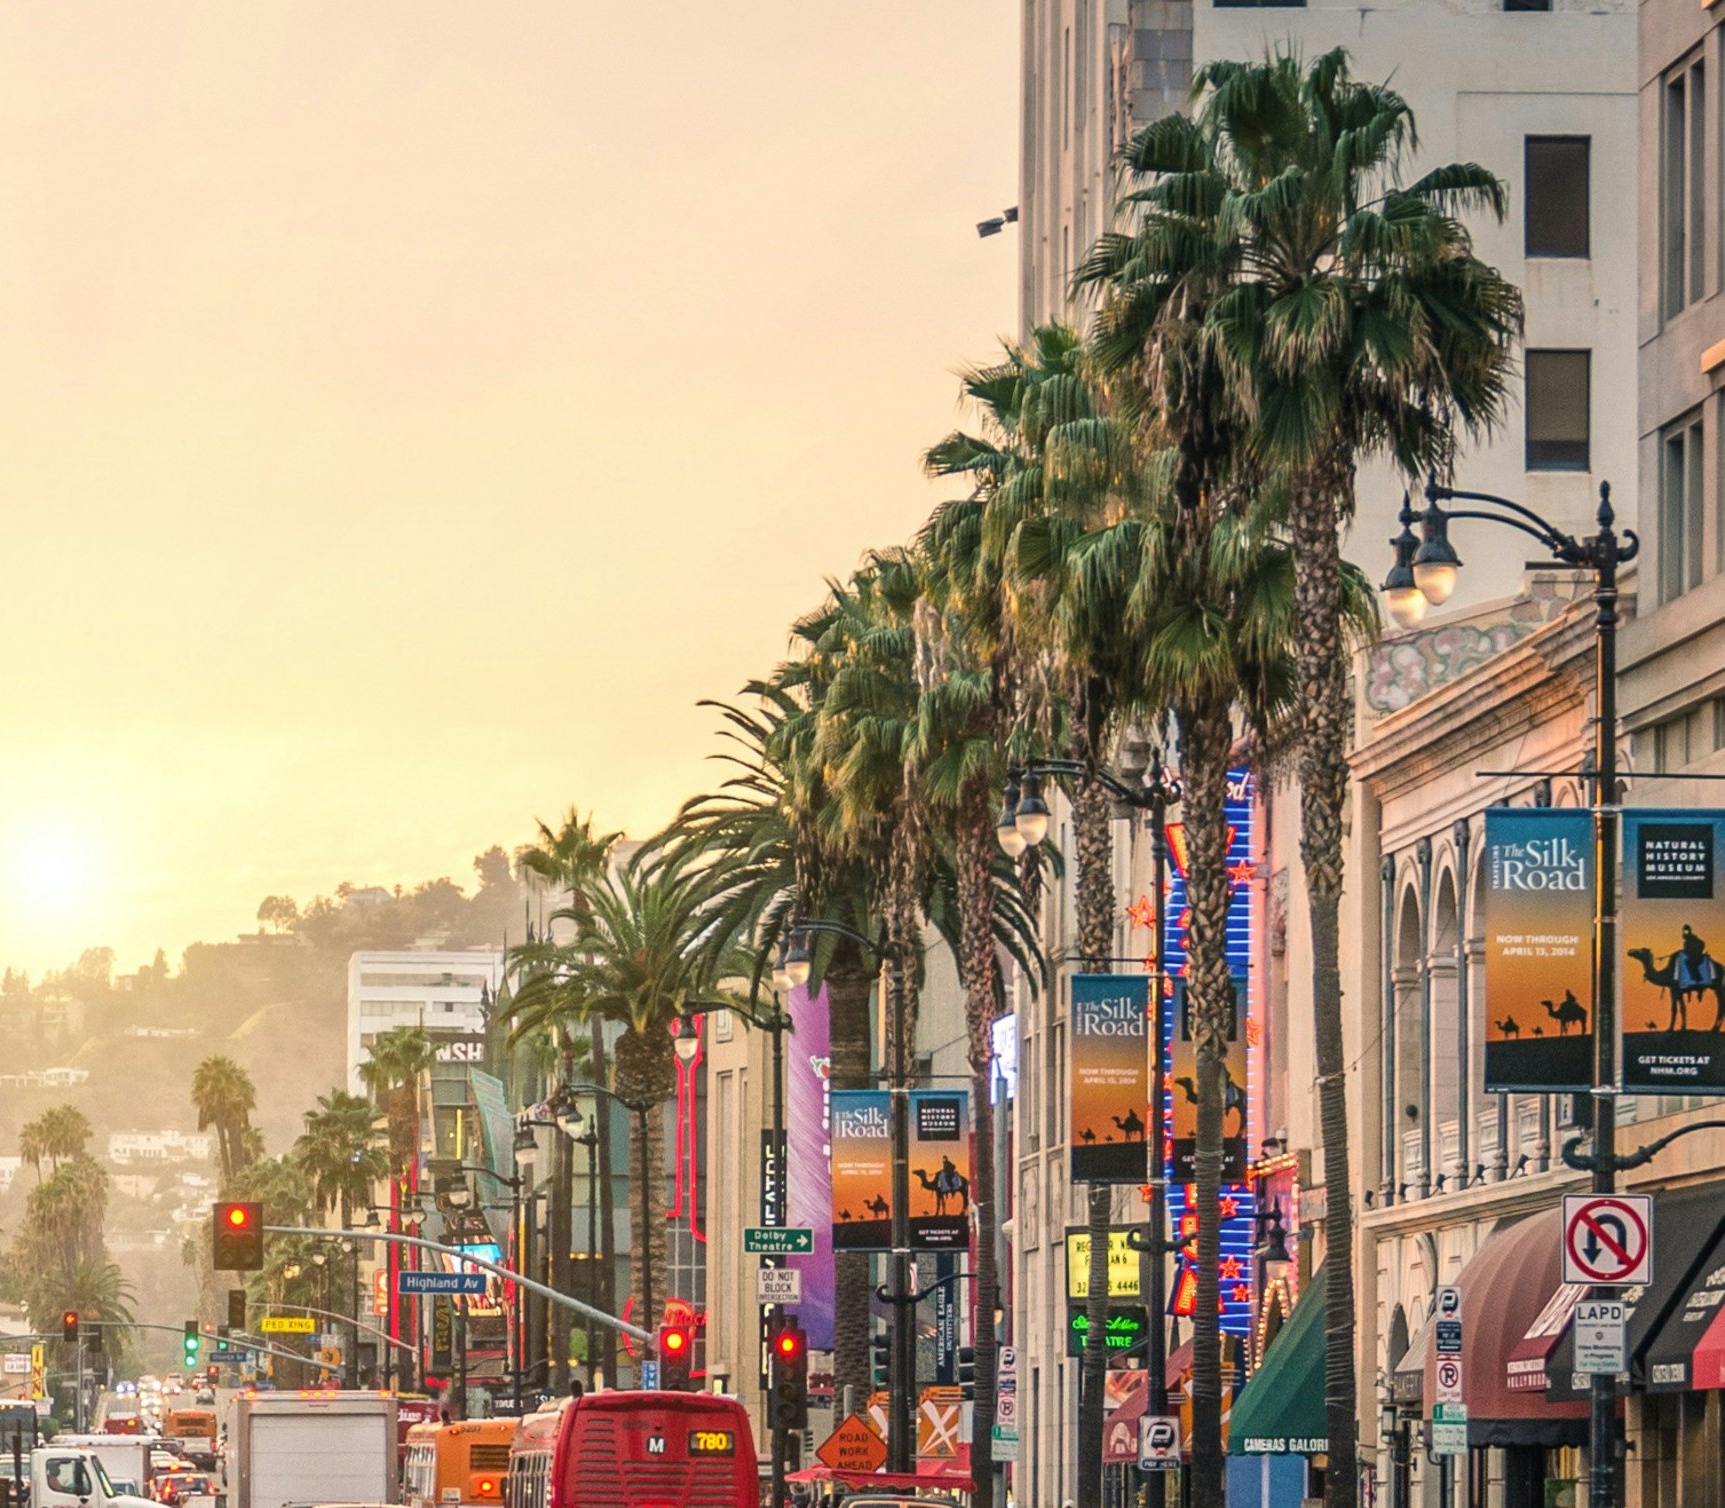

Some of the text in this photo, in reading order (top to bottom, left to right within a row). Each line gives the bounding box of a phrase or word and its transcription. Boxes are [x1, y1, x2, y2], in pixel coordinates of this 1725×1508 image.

[1645, 840, 1705, 850] NATURAL
[1503, 837, 1578, 868] The Silk
[1645, 852, 1705, 861] HISTORY
[1645, 863, 1705, 872] MUSEUM
[1503, 857, 1587, 891] Road
[1496, 934, 1579, 944] NOW THROUGH
[1502, 947, 1532, 956] APRIL
[1100, 997, 1138, 1020] Silk
[1084, 1012, 1145, 1037] Road
[1637, 1055, 1710, 1065] GET TICKETS AT
[1650, 1066, 1698, 1075] NHM.ORG
[853, 1106, 884, 1125] Silk
[840, 1119, 889, 1138] Road
[754, 1230, 787, 1242] Dolby
[749, 1241, 793, 1251] Theatre
[761, 1271, 794, 1282] DO NOT
[406, 1276, 479, 1291] Highland Av
[764, 1282, 792, 1293] BLOCK
[1577, 1306, 1621, 1320] LAPD
[265, 1320, 312, 1330] PED XING
[937, 1313, 945, 1367] AMERICAN
[696, 1431, 728, 1451] 780
[838, 1432, 869, 1443] ROAD
[1244, 1438, 1286, 1452] CAMERAS
[838, 1446, 869, 1457] WORK
[837, 1459, 873, 1471] AHEAD
